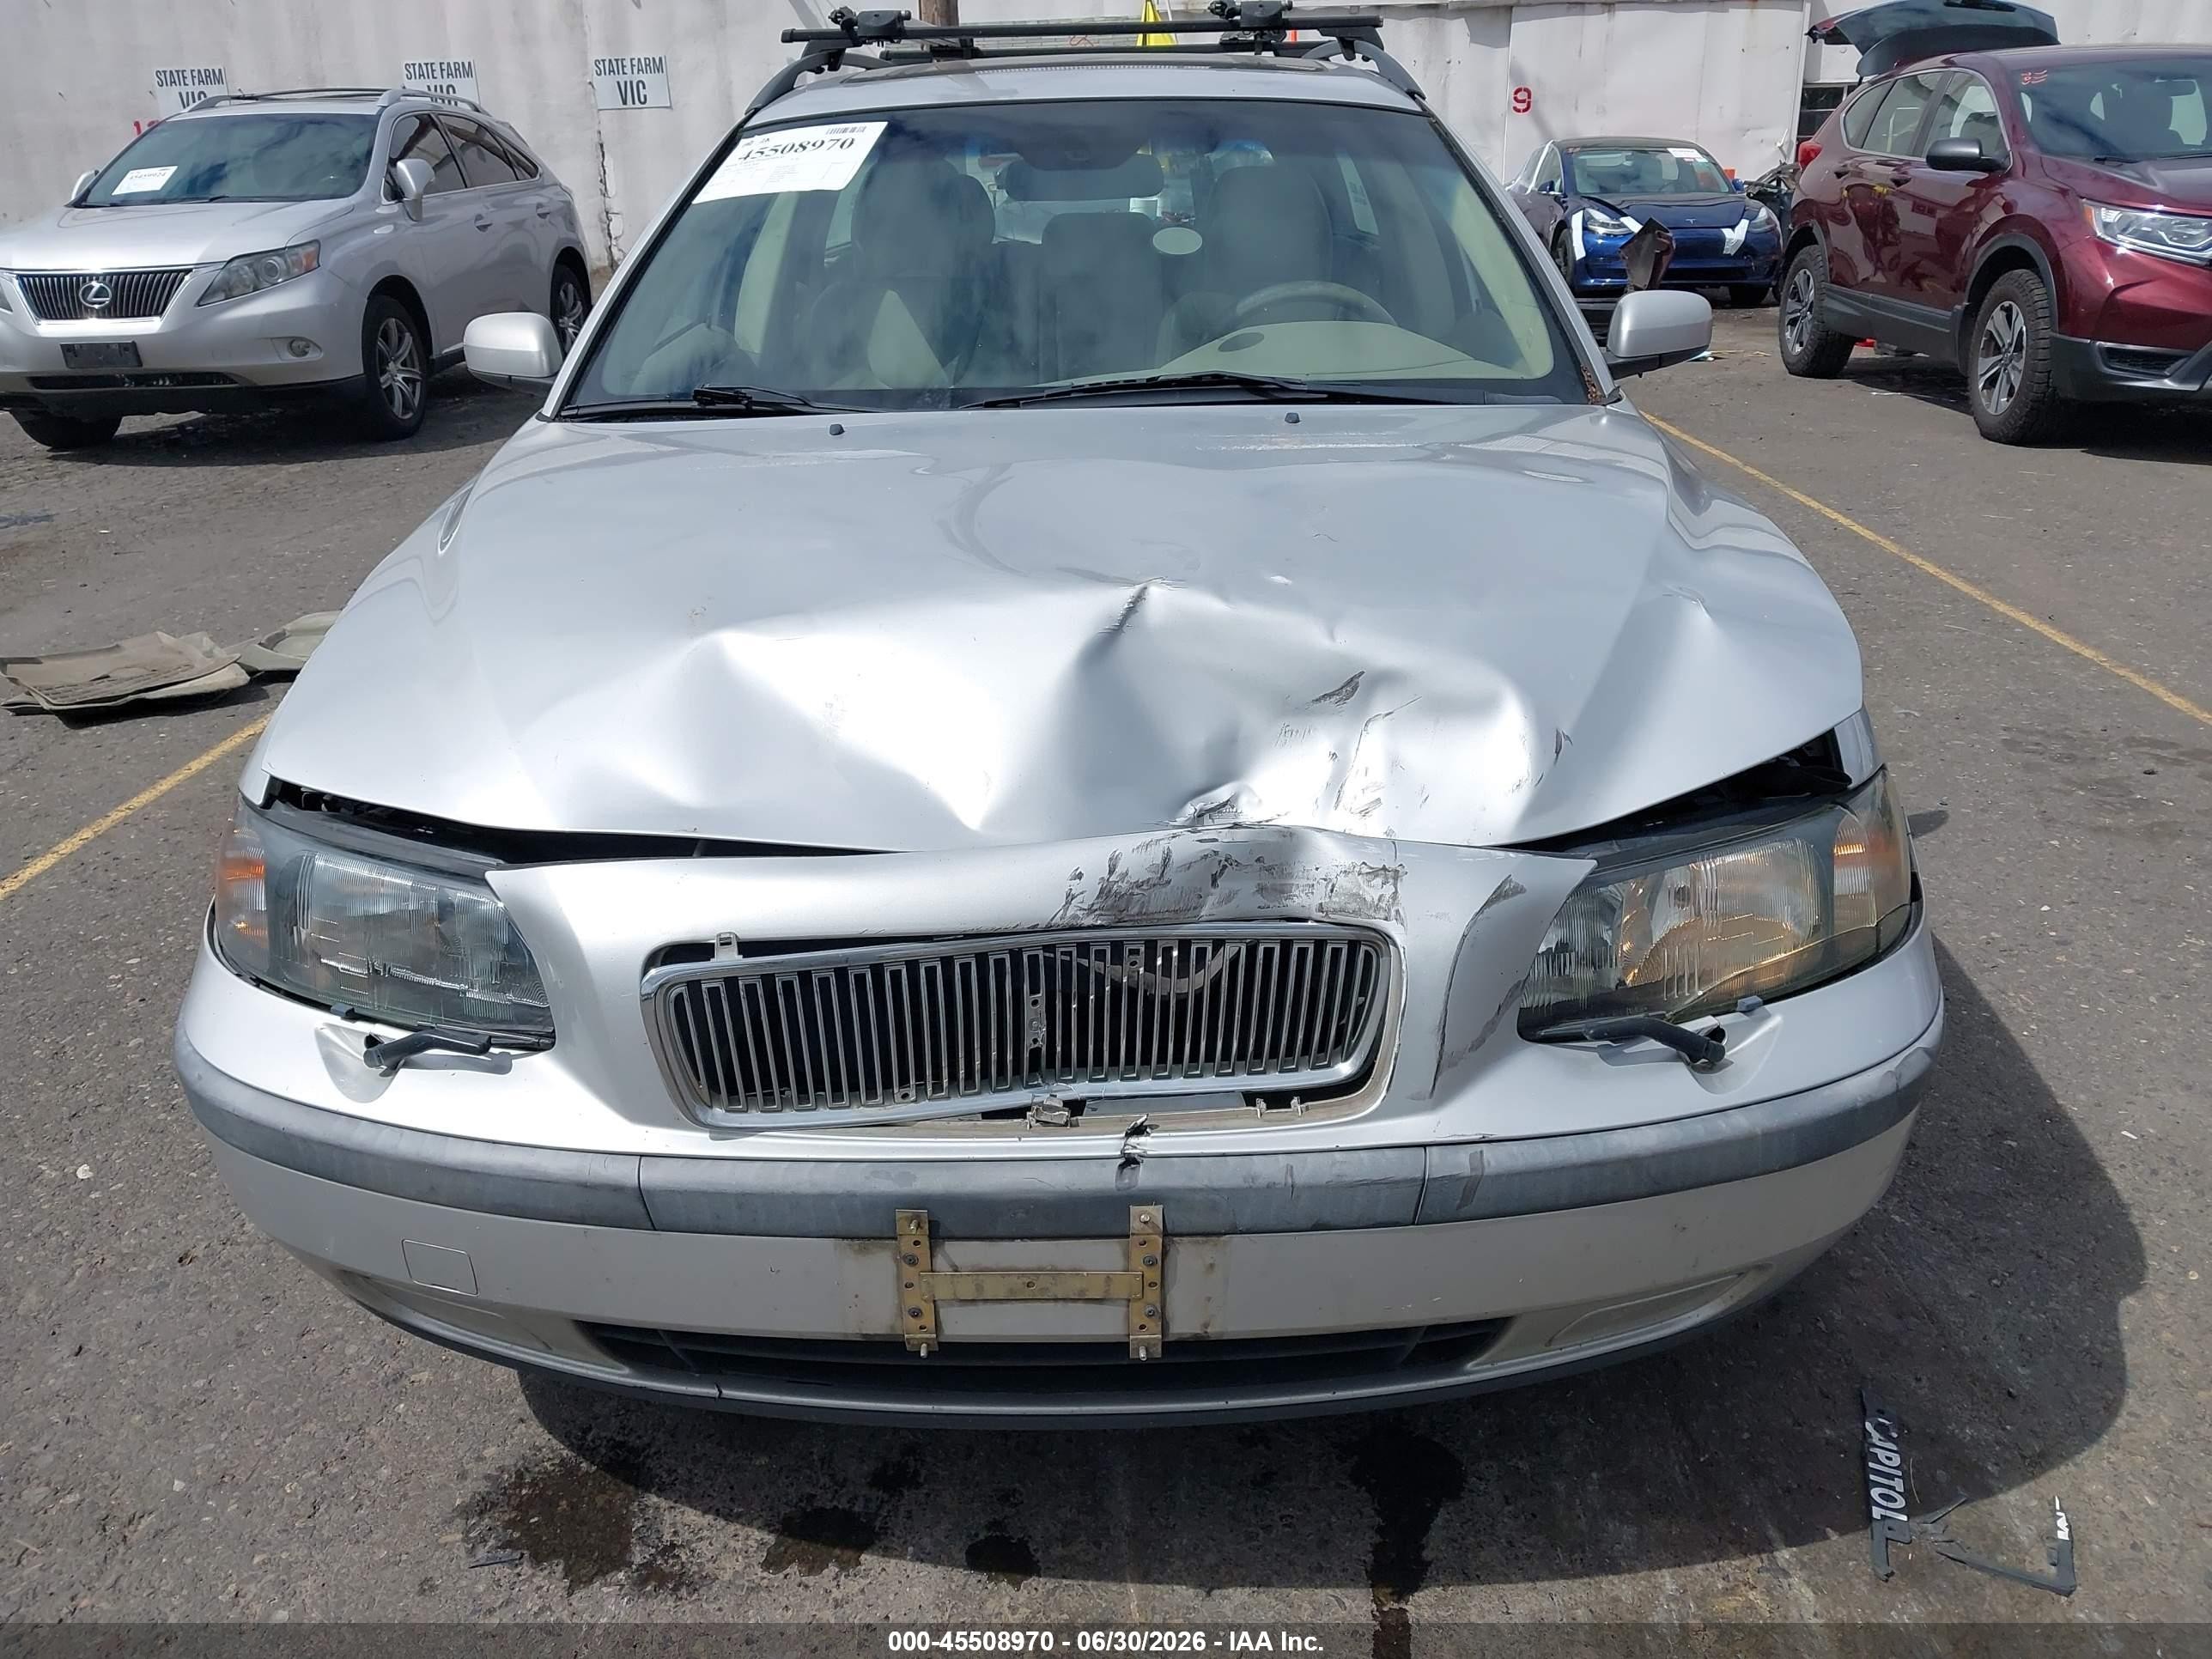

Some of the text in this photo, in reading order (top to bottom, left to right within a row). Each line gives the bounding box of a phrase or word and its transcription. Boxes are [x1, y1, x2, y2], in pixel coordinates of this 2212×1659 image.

[404, 61, 473, 80] STATE FARM
[593, 56, 665, 76] STATE FARM
[155, 68, 224, 88] STATE FARM
[617, 80, 647, 106] VIC
[1512, 87, 1532, 113] 9
[738, 137, 855, 161] 45508970
